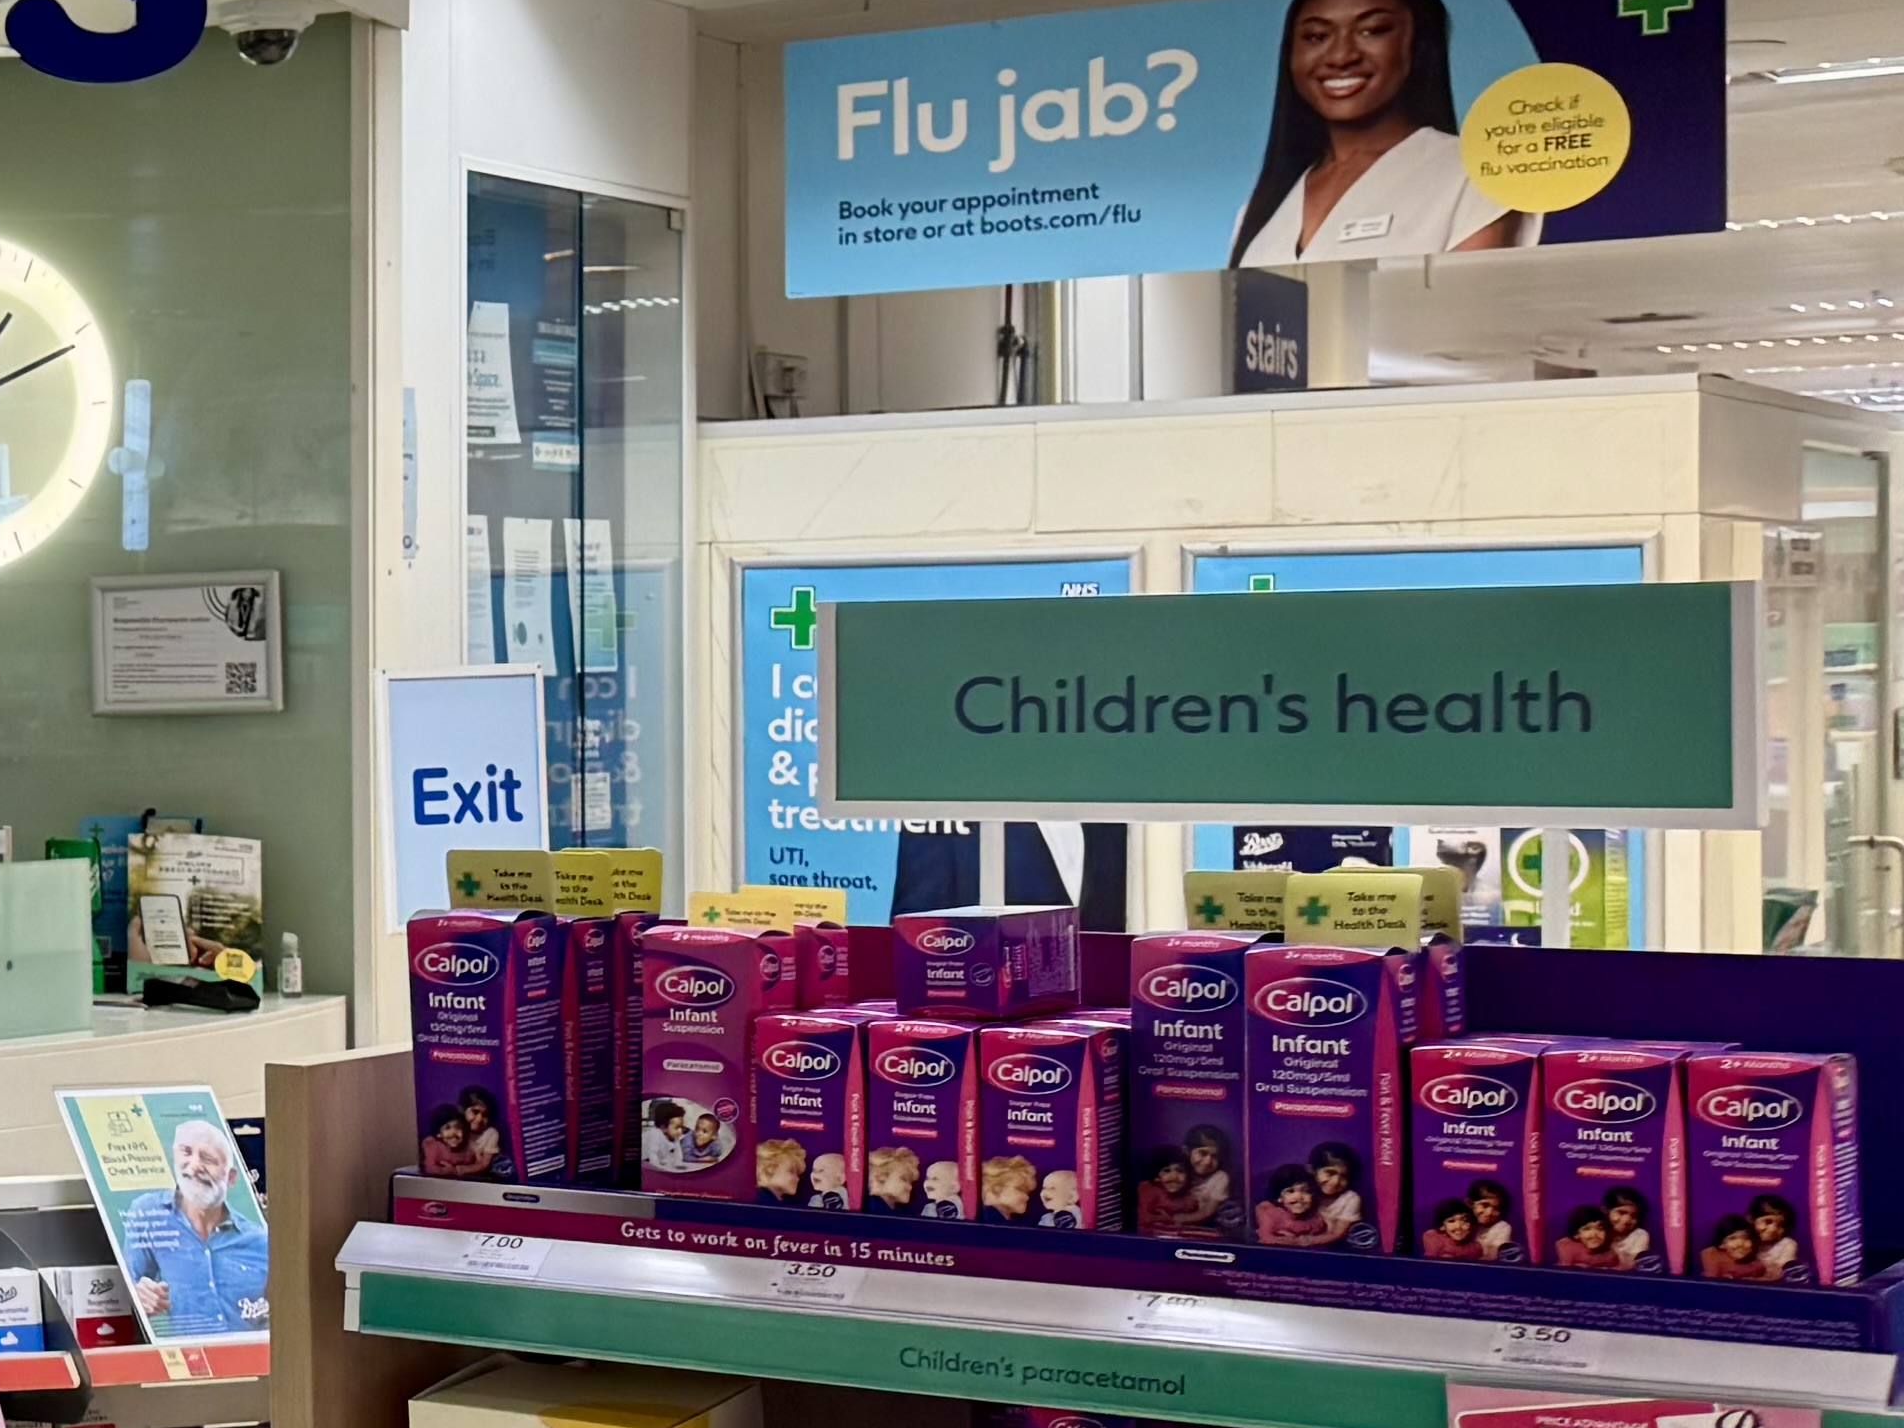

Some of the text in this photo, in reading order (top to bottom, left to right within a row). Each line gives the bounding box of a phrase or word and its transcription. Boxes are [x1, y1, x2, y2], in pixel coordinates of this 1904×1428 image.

[838, 49, 1198, 172] Flu jab?
[1509, 95, 1580, 115] Check if
[1485, 115, 1604, 139] you're eligible
[1497, 134, 1592, 155] for a FREE
[1480, 155, 1608, 177] flu vaccination
[839, 183, 1099, 220] Book your appointment
[839, 204, 1141, 245] in store or at boots.com/flu
[1246, 322, 1297, 380] stairs
[1062, 583, 1099, 596] NHS
[955, 670, 1592, 735] Children's health
[769, 751, 799, 786] &
[413, 764, 523, 825] Exit
[770, 847, 809, 867] UTI,
[769, 871, 877, 891] sore throat.
[1347, 892, 1396, 903] Take me
[1352, 907, 1387, 916] to the
[1334, 919, 1406, 930] Health Desk
[923, 934, 968, 949] Calpol
[424, 952, 488, 974] Calpol
[428, 992, 486, 1010] Infant
[1267, 989, 1353, 1018] Calpol
[663, 1022, 724, 1036] Suspension
[1153, 1020, 1223, 1040] Infant
[1283, 1056, 1339, 1070] Original
[1256, 1083, 1367, 1098] Oral Suspension
[1708, 1095, 1789, 1121] Calpol
[621, 1221, 955, 1267] Gets to work on fever in 15 minutes
[900, 1348, 1185, 1396] Children's paracetamol
